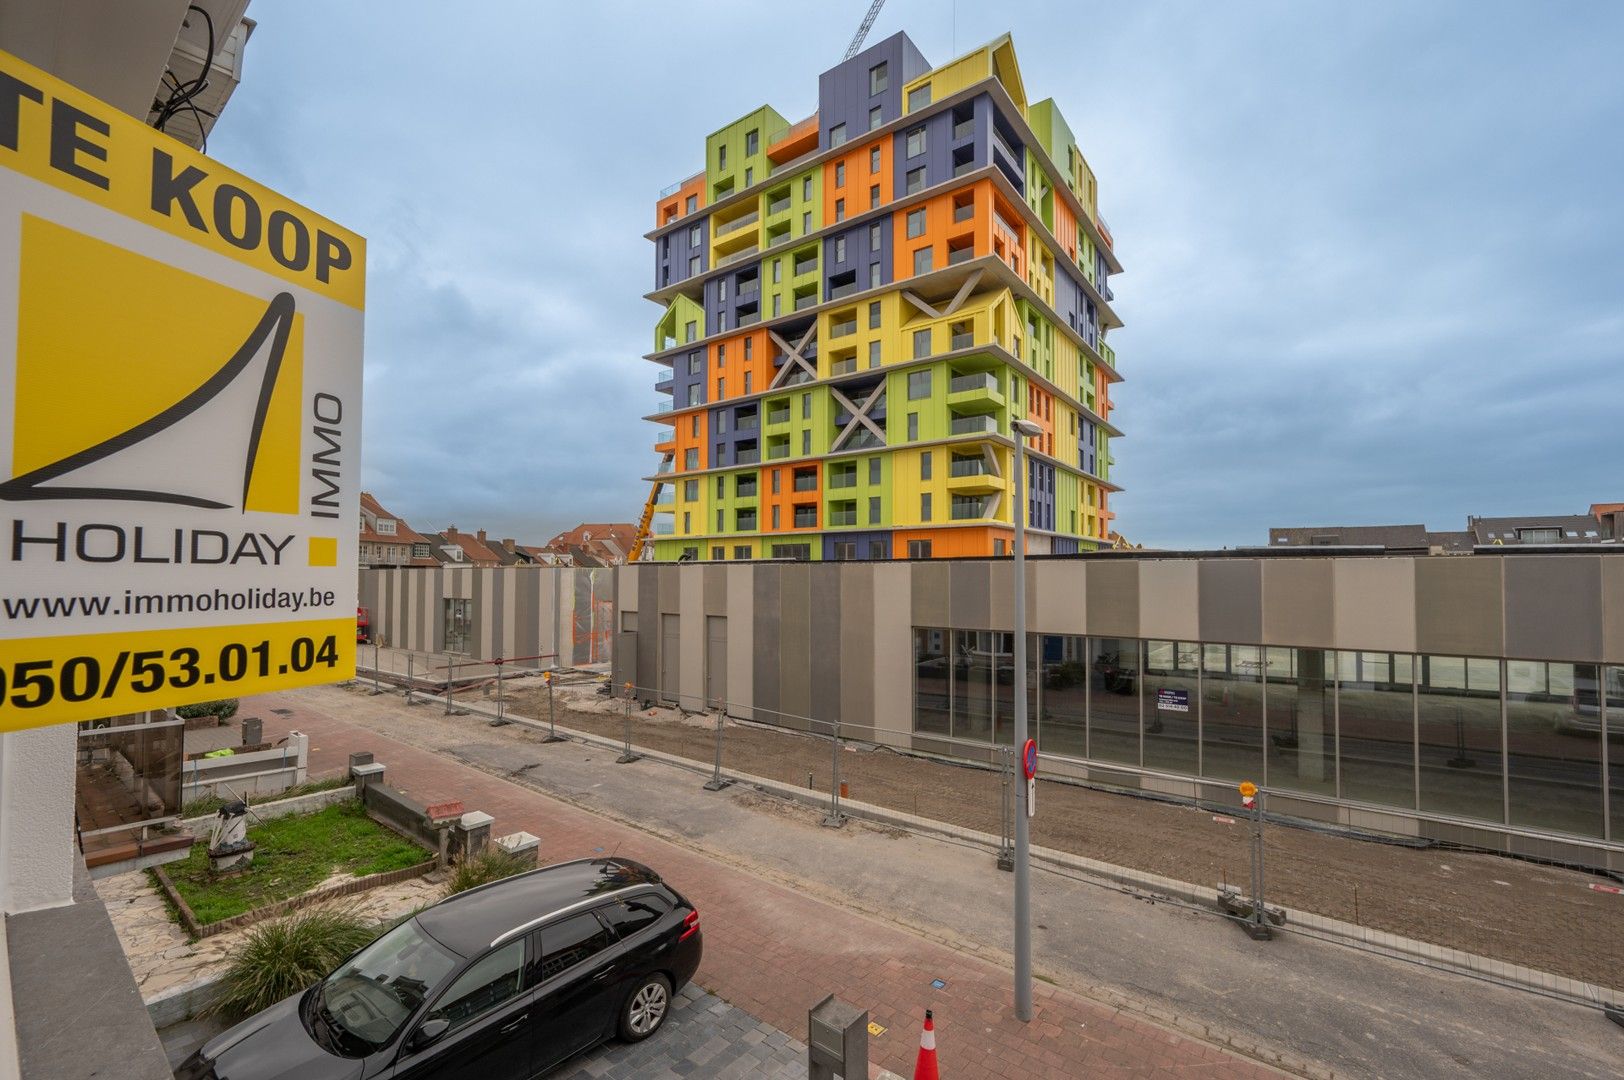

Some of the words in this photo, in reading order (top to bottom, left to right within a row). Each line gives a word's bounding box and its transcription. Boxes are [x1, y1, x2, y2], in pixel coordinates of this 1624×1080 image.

[150, 147, 352, 284] KOOP
[311, 392, 343, 518] IMMO
[11, 519, 296, 566] HOLIDAY
[5, 587, 336, 619] www.immoholiday.be
[0, 635, 339, 709] 50/53.01.04
